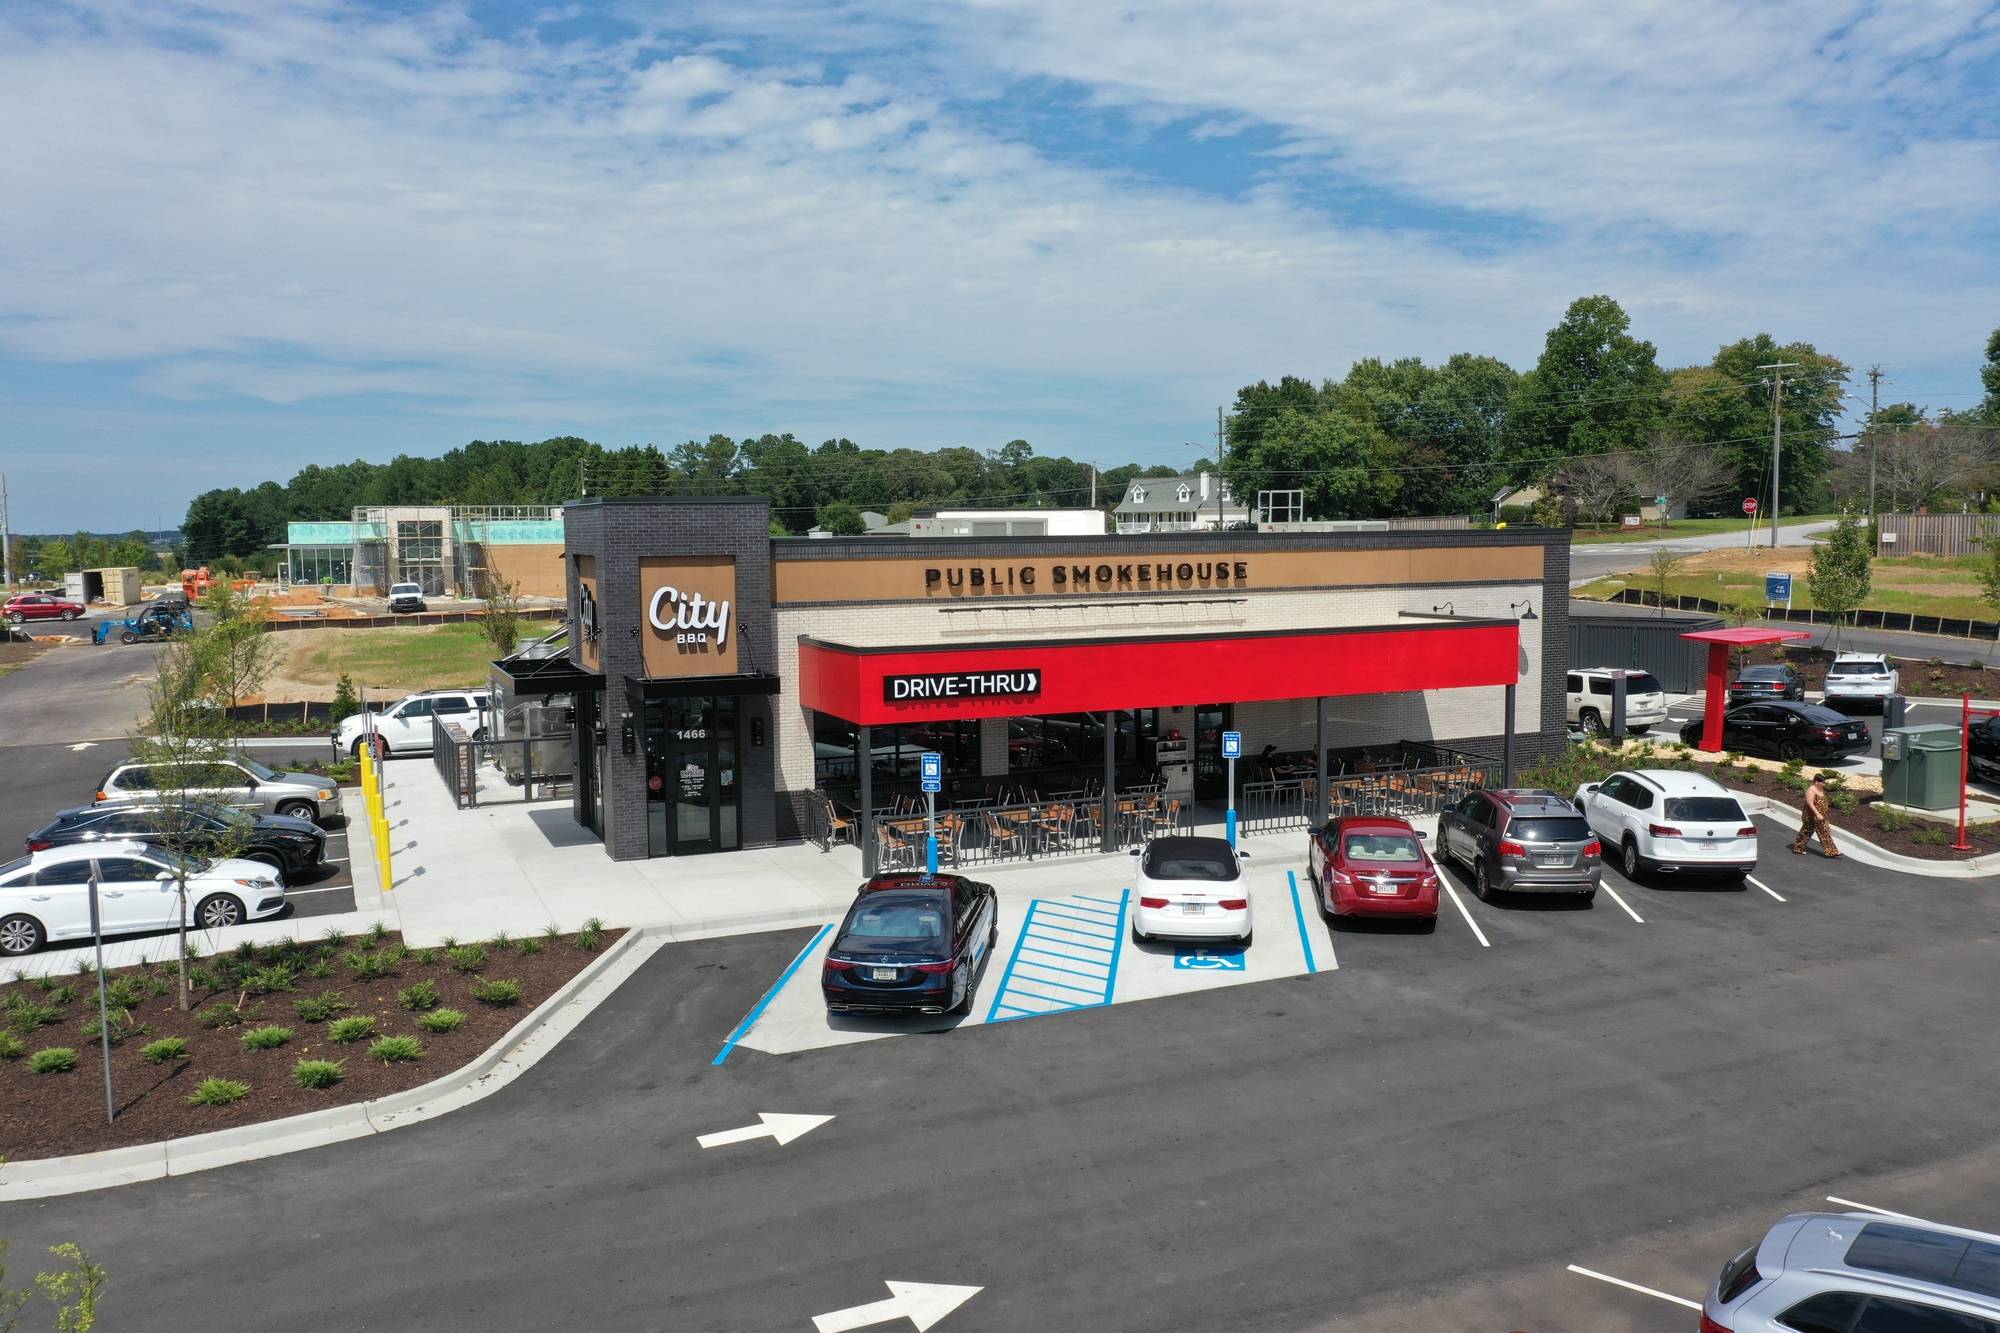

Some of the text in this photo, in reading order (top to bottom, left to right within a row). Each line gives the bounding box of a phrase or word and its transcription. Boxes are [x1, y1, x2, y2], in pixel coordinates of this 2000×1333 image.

[925, 562, 1248, 587] PUBLIC SMOKEHOUSE
[649, 586, 729, 645] City
[677, 633, 706, 644] BBQ
[894, 673, 1025, 698] DRIVE-THRU
[676, 729, 706, 740] 1466
